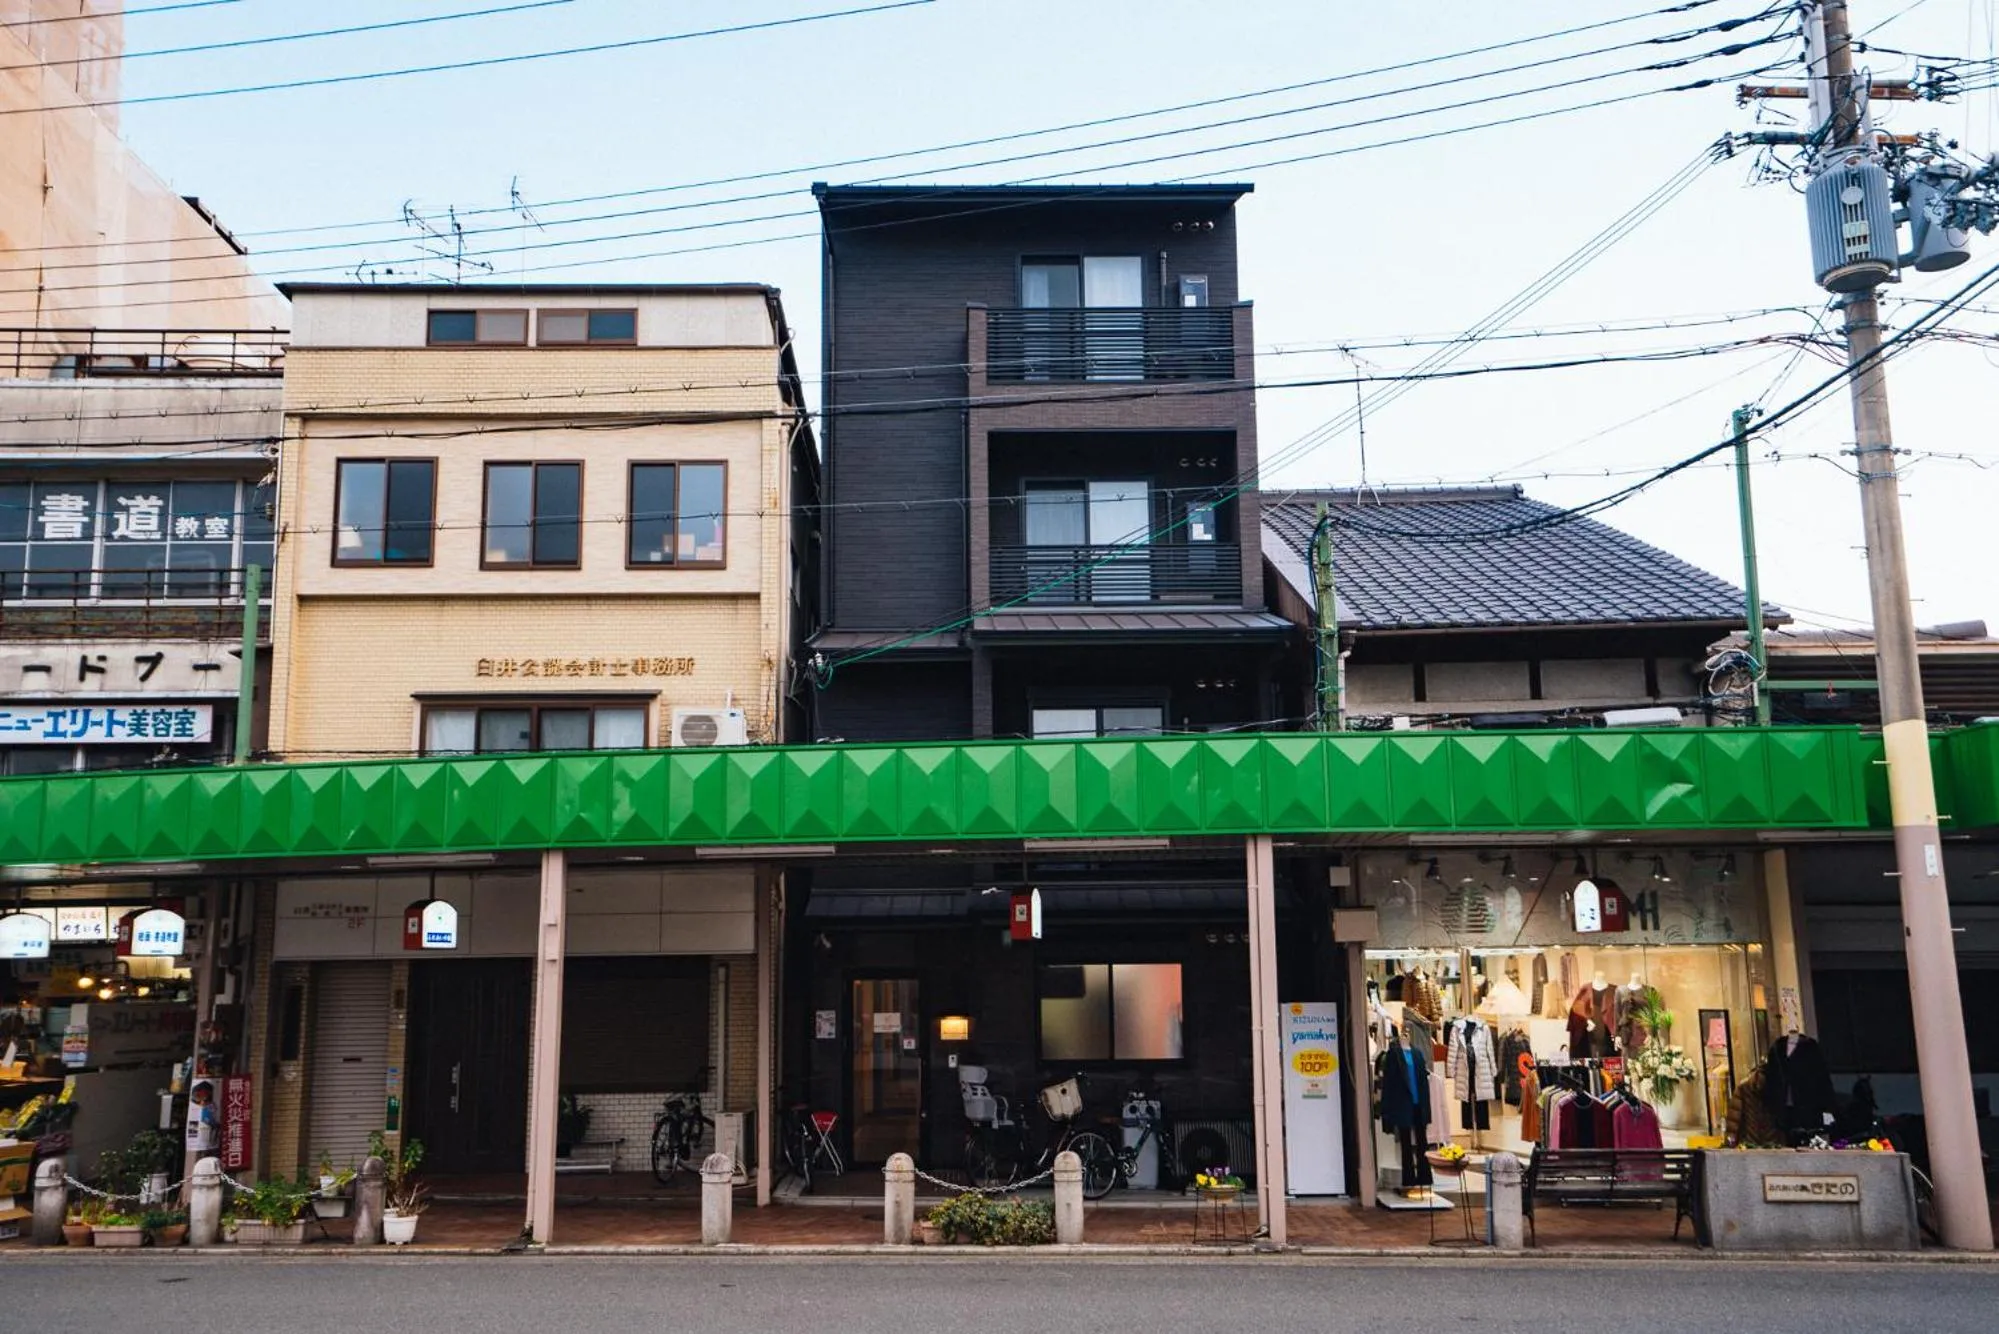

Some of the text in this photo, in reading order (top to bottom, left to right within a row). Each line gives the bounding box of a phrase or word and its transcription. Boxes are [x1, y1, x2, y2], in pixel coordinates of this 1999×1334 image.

[0, 709, 196, 738] ニューエリート美容室
